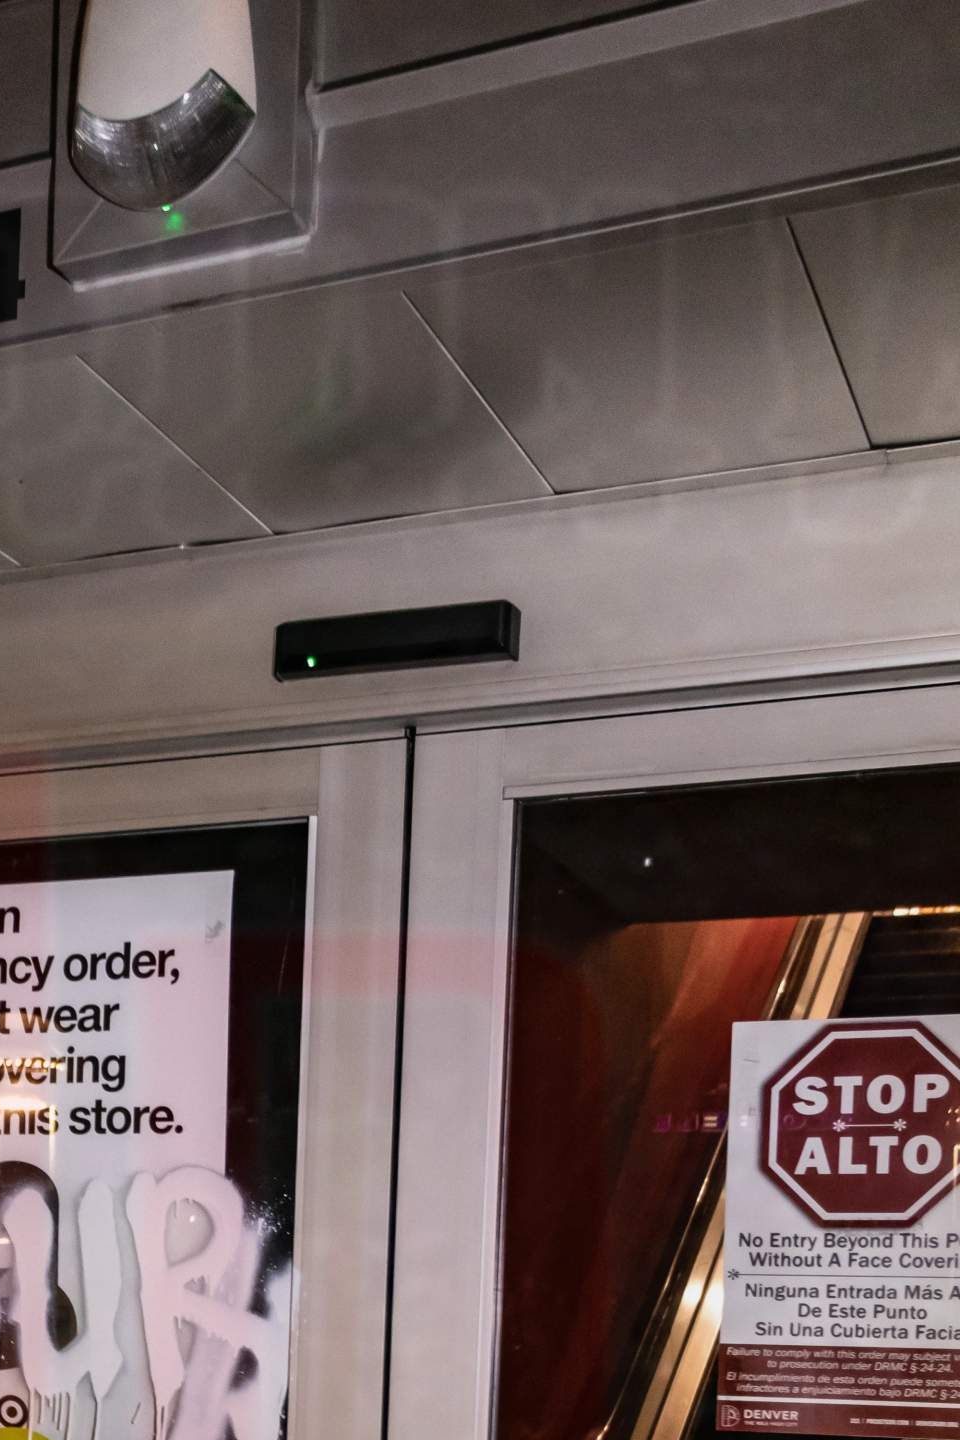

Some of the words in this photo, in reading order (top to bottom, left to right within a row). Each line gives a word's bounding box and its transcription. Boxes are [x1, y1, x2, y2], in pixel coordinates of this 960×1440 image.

[63, 942, 180, 983] order,
[19, 1002, 120, 1034] wear
[792, 1074, 950, 1116] STOP
[69, 1100, 184, 1136] store.
[794, 1135, 943, 1175] ALTO
[738, 1233, 763, 1248] No
[770, 1233, 817, 1251] Entry
[824, 1233, 893, 1251] Beyond
[900, 1233, 939, 1249] This
[749, 1252, 822, 1268] Without
[828, 1253, 841, 1267] A
[848, 1253, 892, 1268] Face
[745, 1283, 819, 1301] Ninguna
[826, 1284, 897, 1300] Entrada
[904, 1284, 943, 1300] Más
[798, 1303, 822, 1318] De
[829, 1304, 866, 1319] Este
[873, 1304, 928, 1320] Punto
[754, 1321, 783, 1336] Sin
[790, 1322, 824, 1337] Una
[830, 1323, 908, 1340] Cubierta
[726, 1347, 760, 1357] Failure
[763, 1349, 773, 1357] to
[775, 1350, 811, 1359] comply
[813, 1350, 835, 1358] with
[837, 1351, 856, 1359] this
[858, 1351, 886, 1359] order
[888, 1352, 911, 1361] may
[912, 1352, 952, 1361] subject
[767, 1360, 777, 1368] to
[779, 1361, 839, 1369] prosecution
[841, 1362, 872, 1370] under
[817, 1375, 831, 1383] de
[743, 1409, 799, 1421] DENVER
